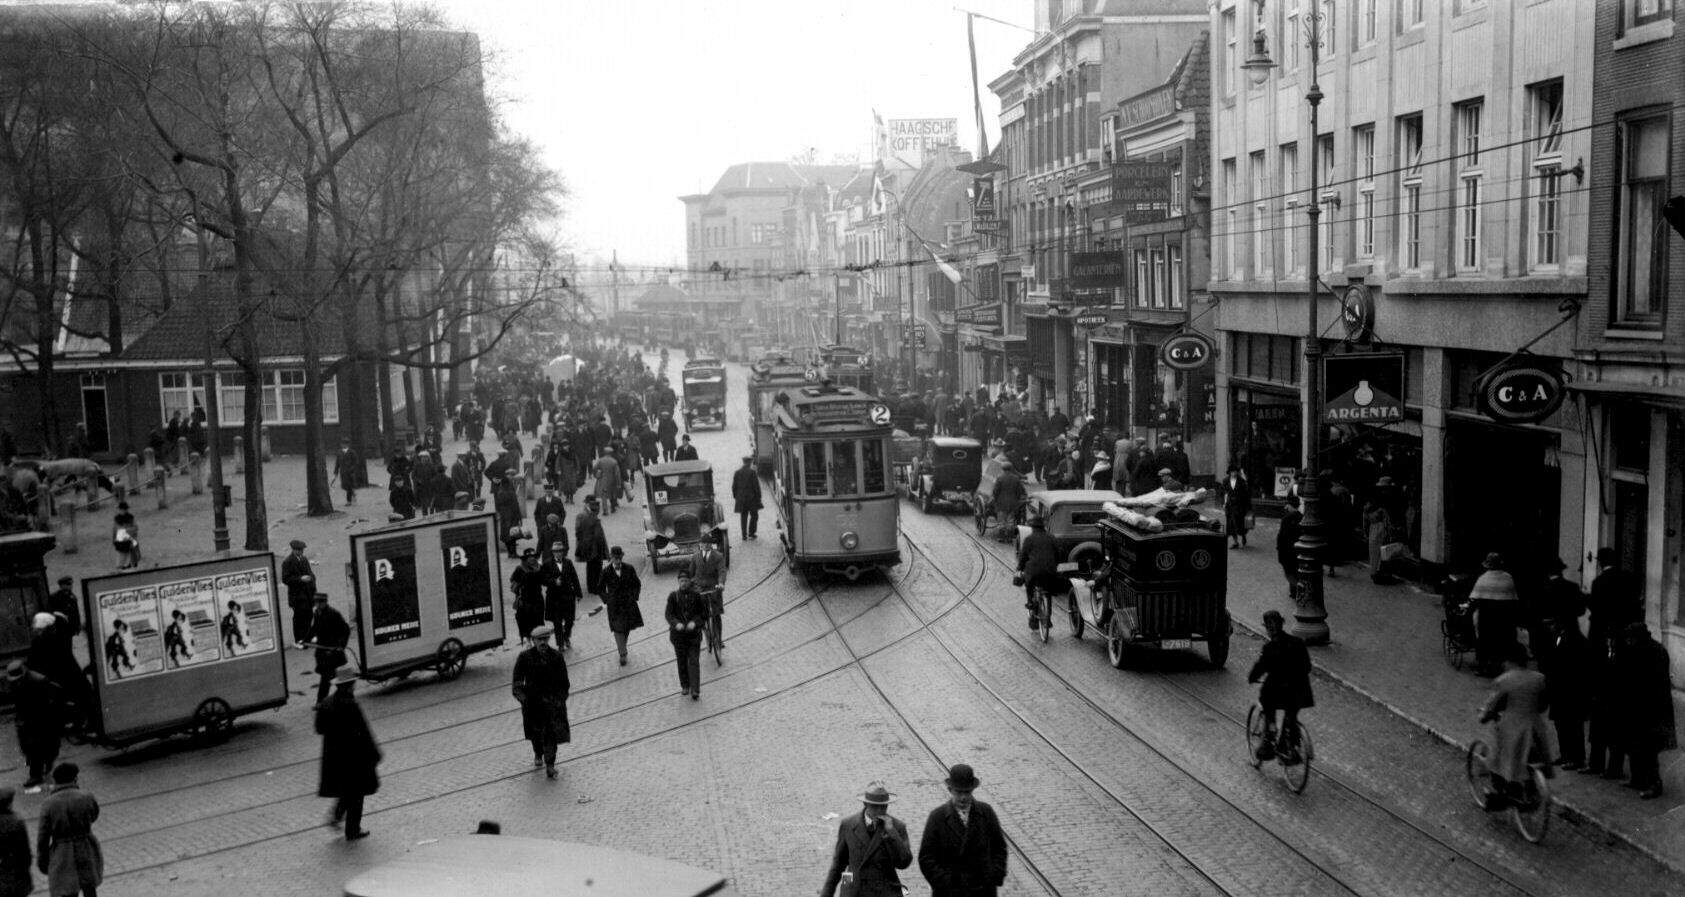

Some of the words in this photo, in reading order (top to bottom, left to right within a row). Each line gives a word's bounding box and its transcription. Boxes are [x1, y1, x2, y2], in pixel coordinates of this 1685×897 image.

[1171, 348, 1180, 359] C
[1192, 347, 1202, 358] A
[1498, 386, 1513, 403] C
[1518, 390, 1527, 402] &
[1532, 384, 1548, 400] A
[875, 405, 887, 422] 2
[1328, 406, 1399, 419] ARGENTA
